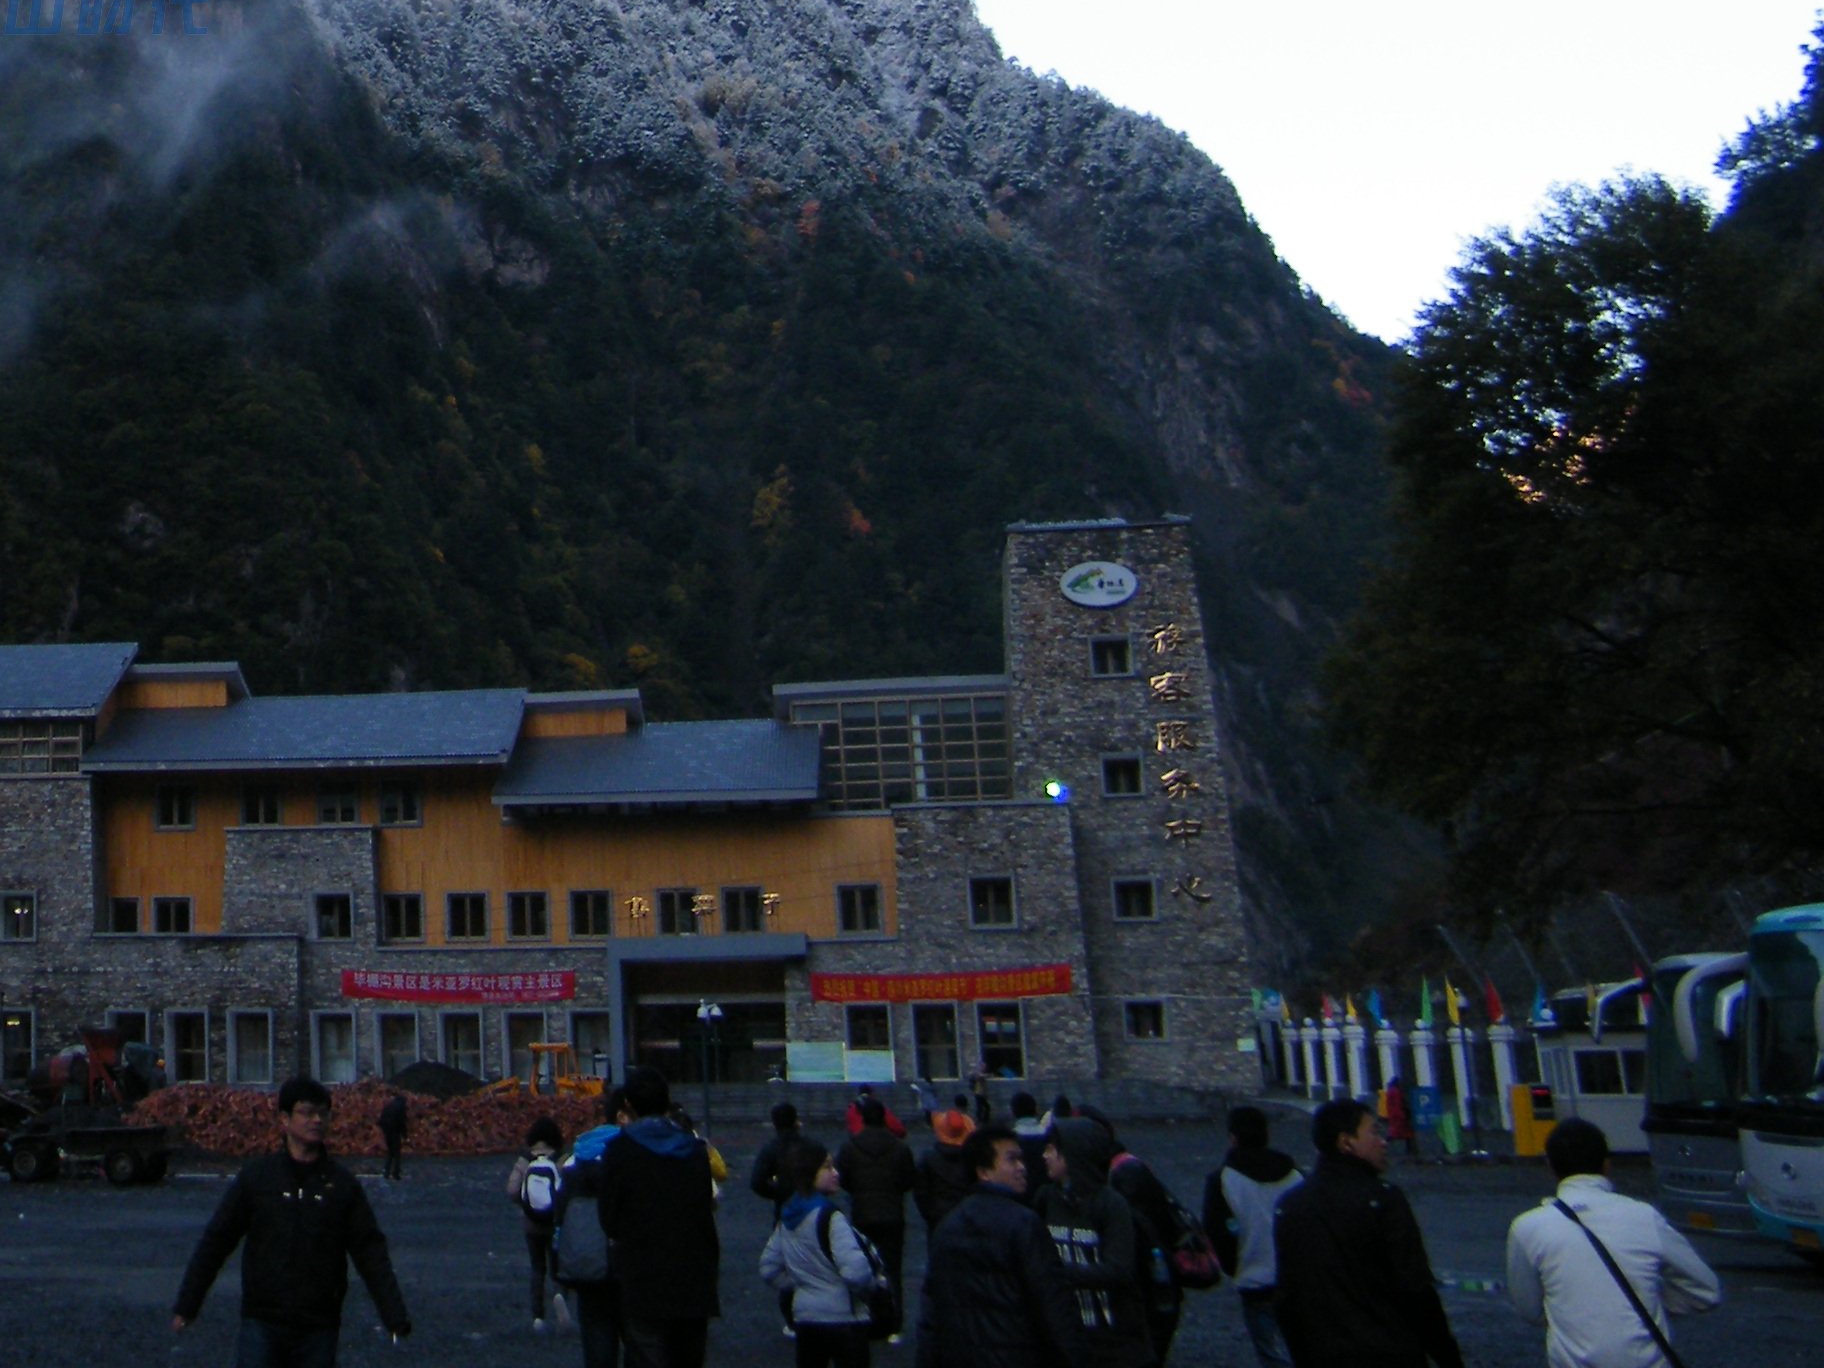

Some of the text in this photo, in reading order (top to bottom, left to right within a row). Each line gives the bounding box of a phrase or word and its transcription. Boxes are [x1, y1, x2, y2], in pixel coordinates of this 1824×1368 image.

[1147, 621, 1213, 904] 游客服务中心
